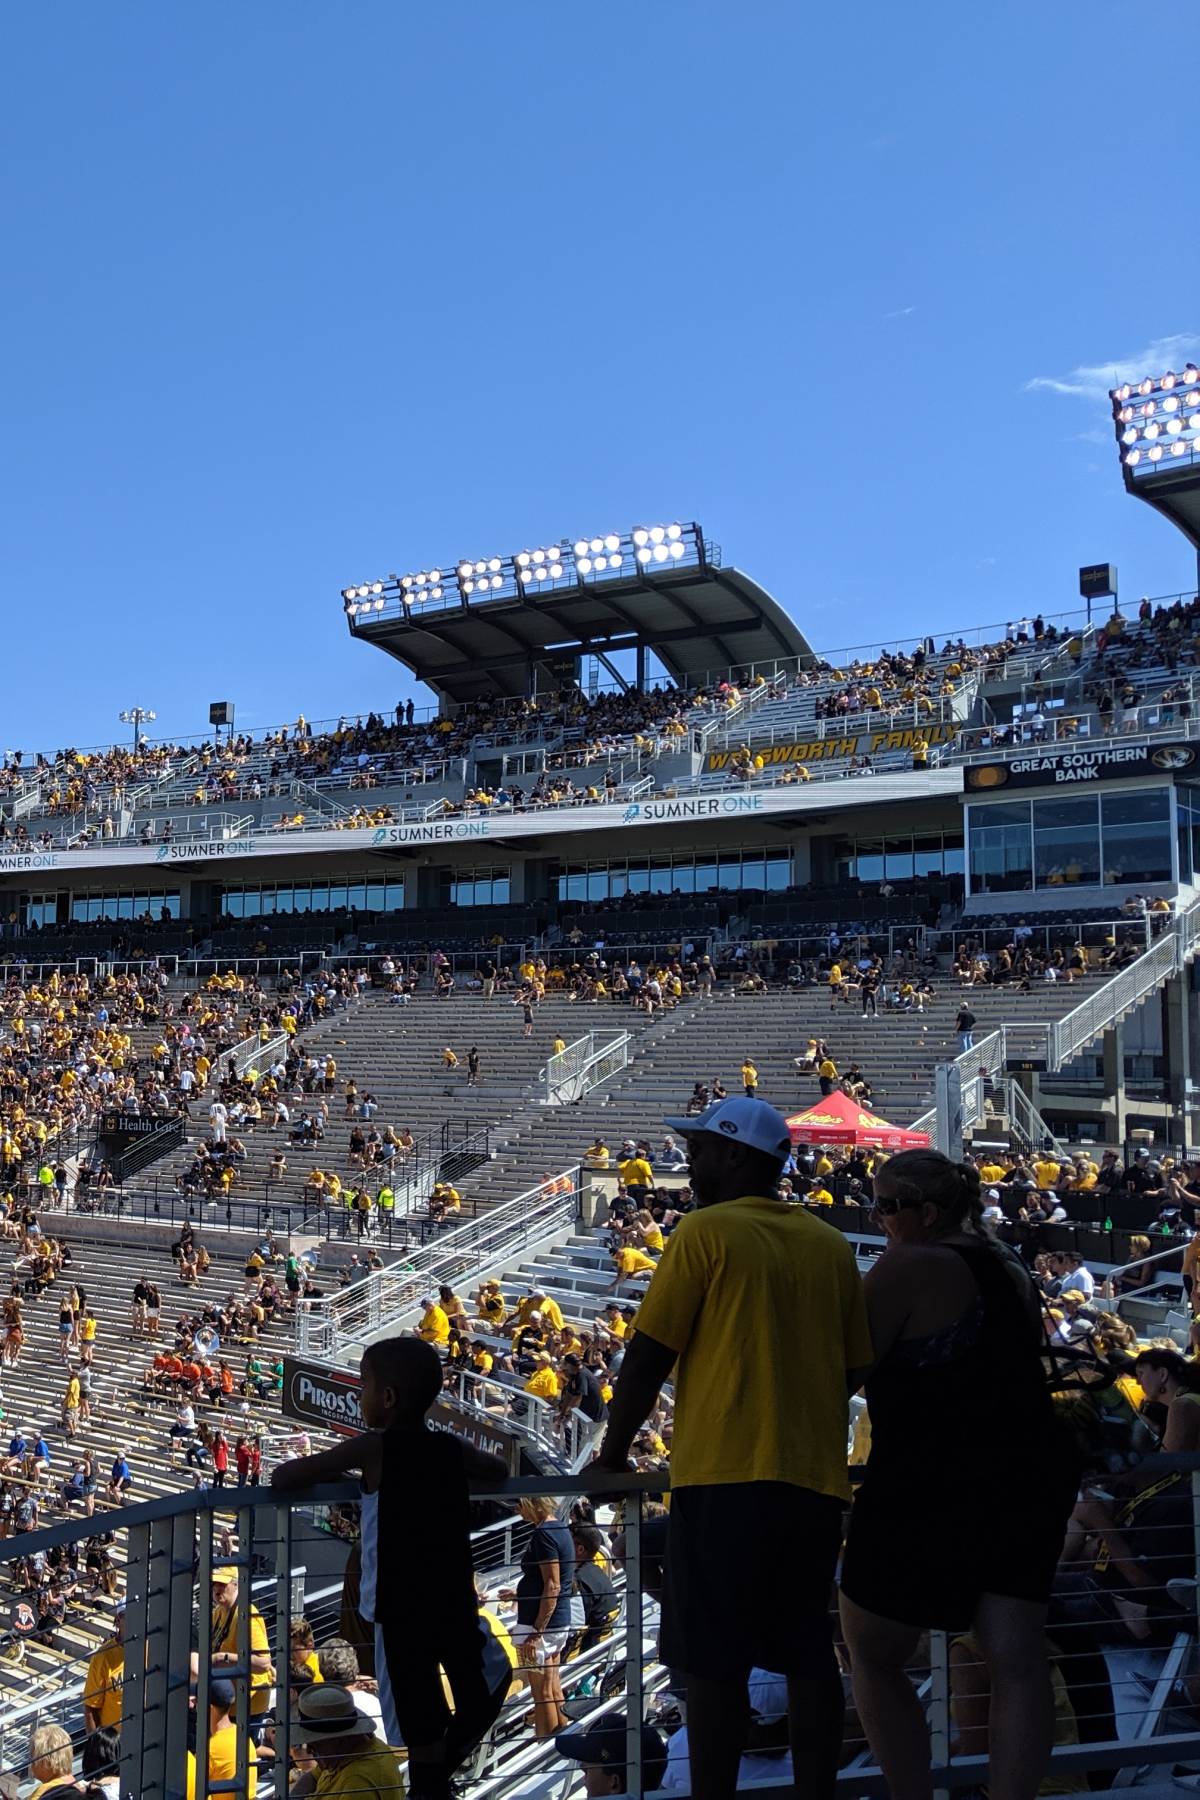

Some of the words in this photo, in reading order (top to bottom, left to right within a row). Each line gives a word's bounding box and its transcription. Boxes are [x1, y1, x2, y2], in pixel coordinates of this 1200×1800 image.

[1010, 757, 1059, 773] GREAT
[1062, 748, 1148, 767] SOUTHERN
[1055, 766, 1100, 782] BANK
[118, 1118, 152, 1132] Health
